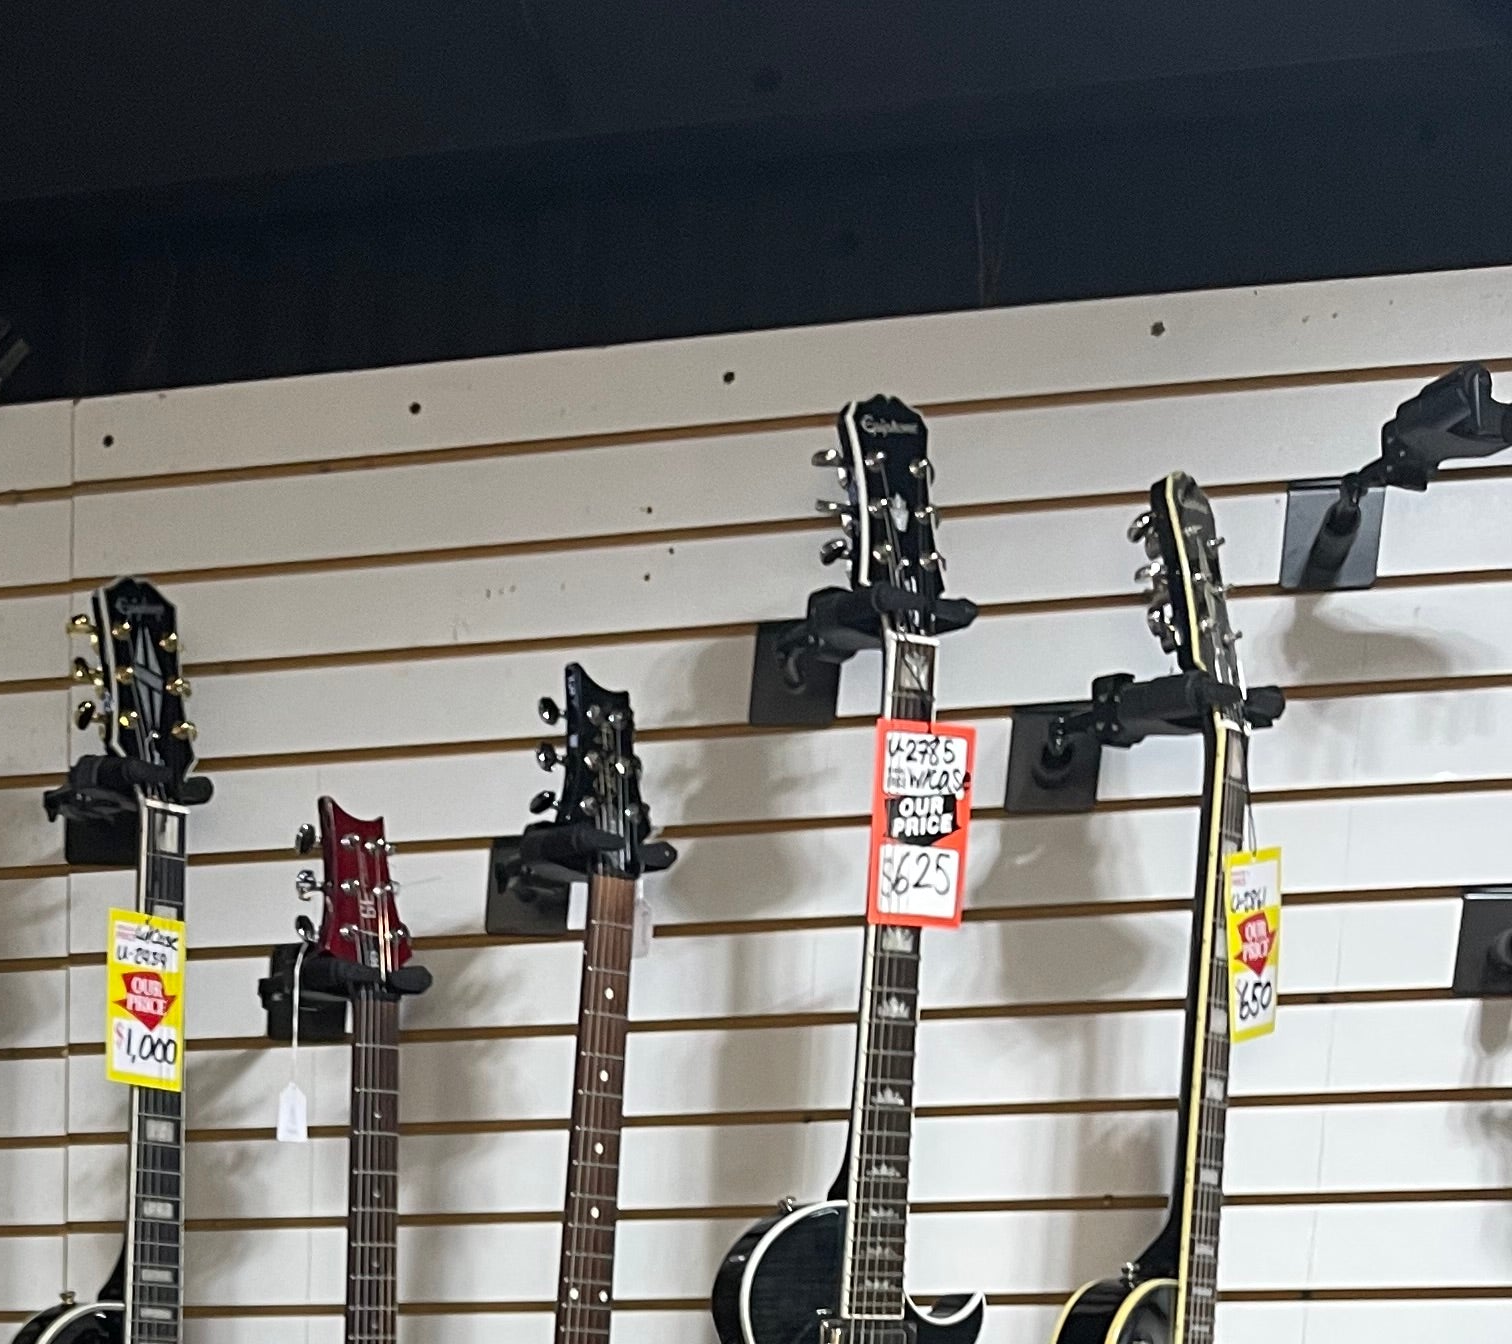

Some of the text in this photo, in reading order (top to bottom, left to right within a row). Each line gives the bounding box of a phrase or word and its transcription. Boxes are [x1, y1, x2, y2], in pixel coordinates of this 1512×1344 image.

[899, 797, 944, 816] OUR
[892, 815, 953, 838] PRICE
[130, 976, 163, 998] OUR
[126, 993, 167, 1015] PRICE
